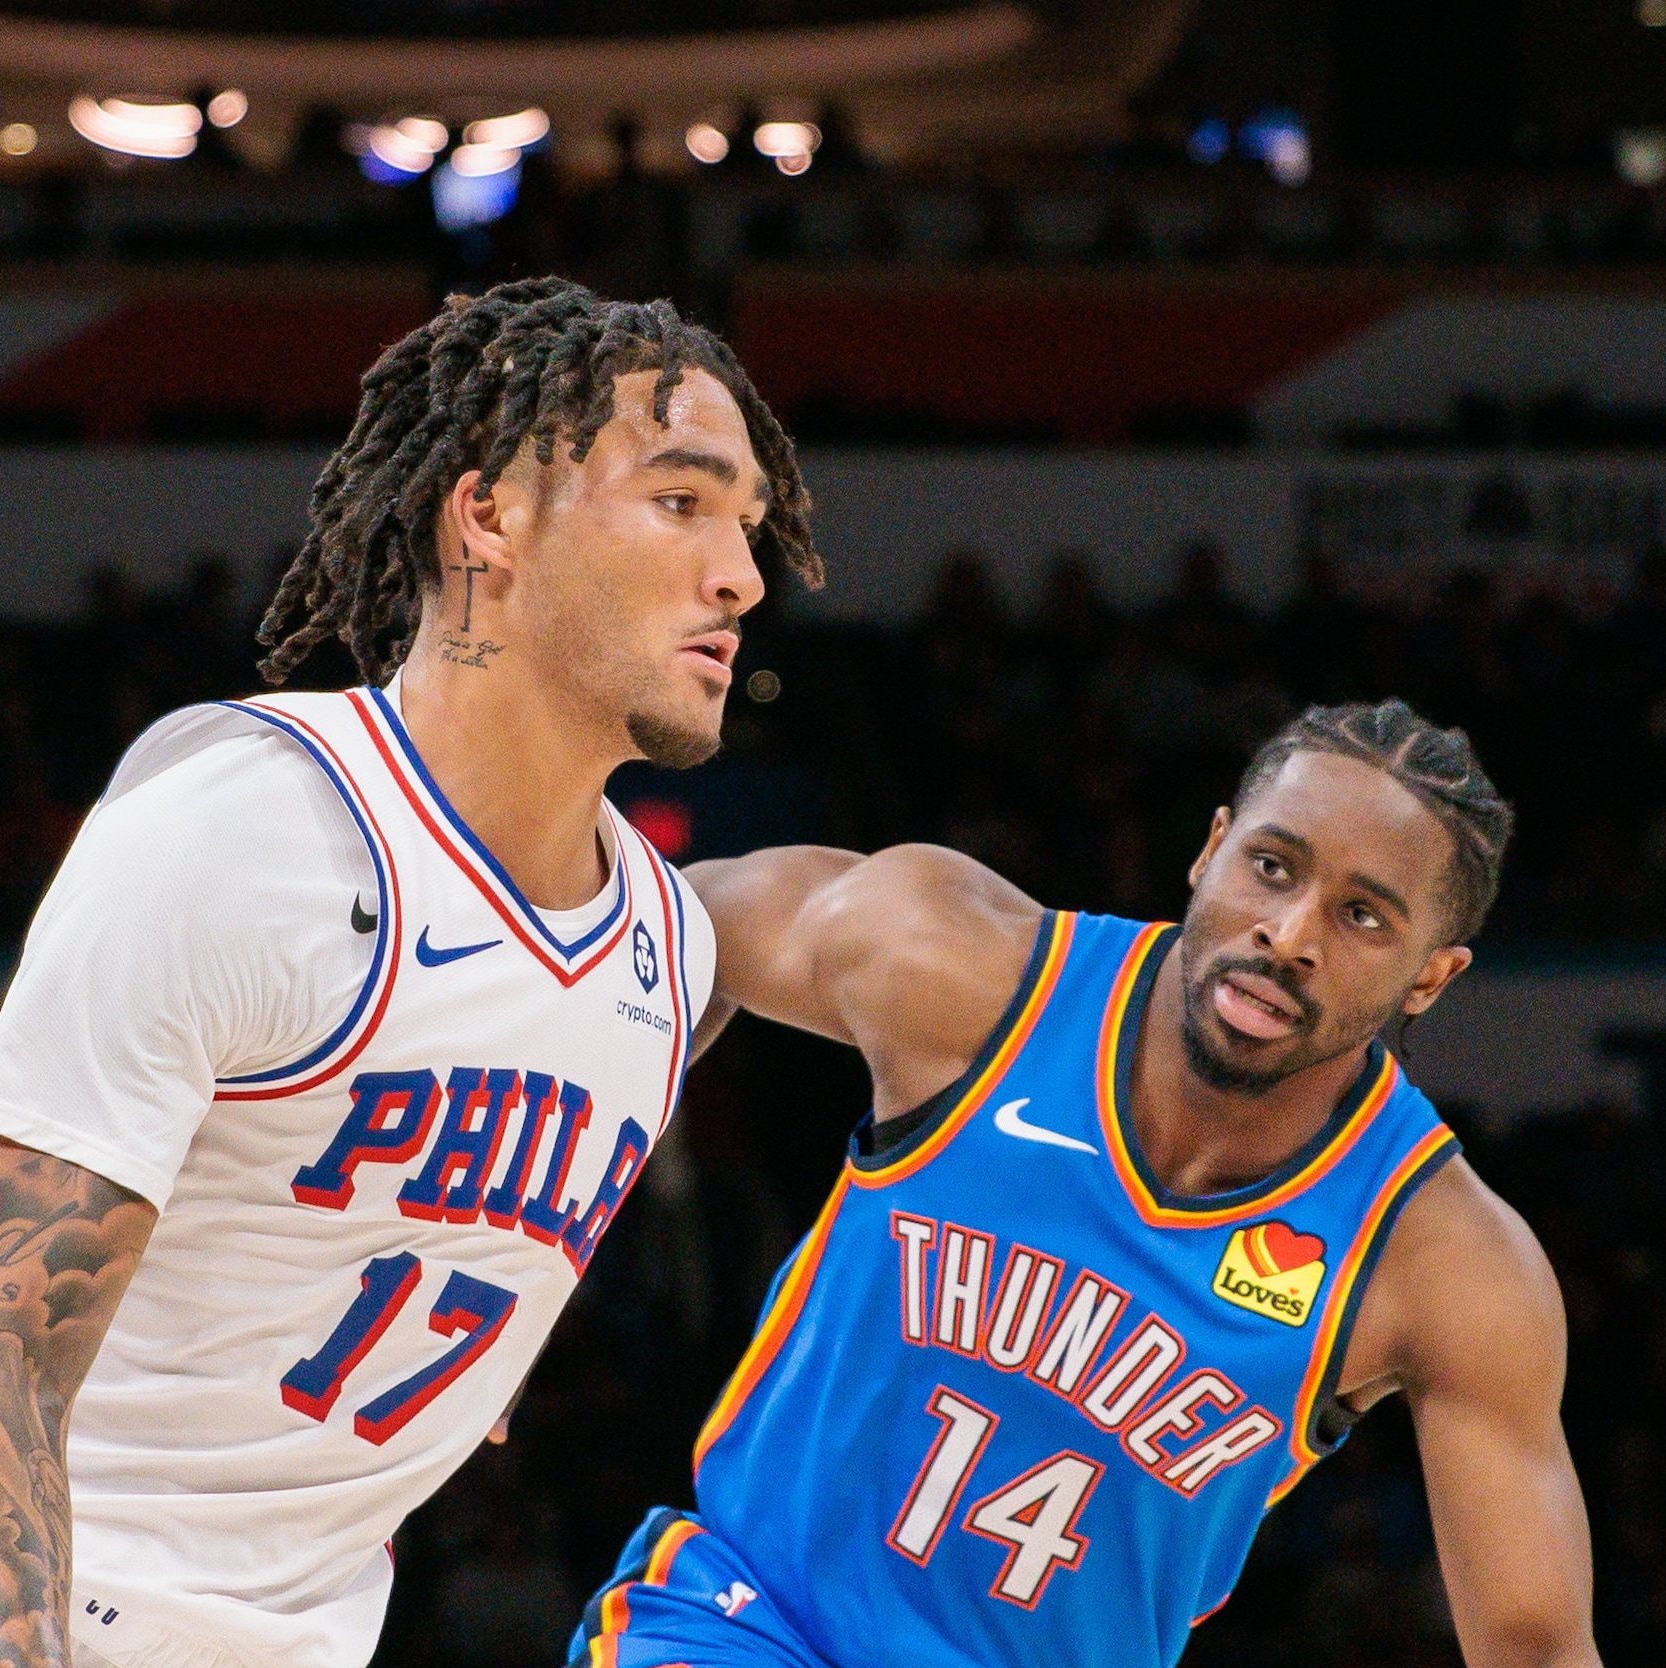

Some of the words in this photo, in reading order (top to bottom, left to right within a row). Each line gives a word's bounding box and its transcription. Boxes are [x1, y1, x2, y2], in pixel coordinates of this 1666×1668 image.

[615, 998, 671, 1037] crypto.com
[280, 1251, 518, 1446] 17
[889, 1211, 1282, 1500] THUNDER
[885, 1384, 1107, 1611] 14
